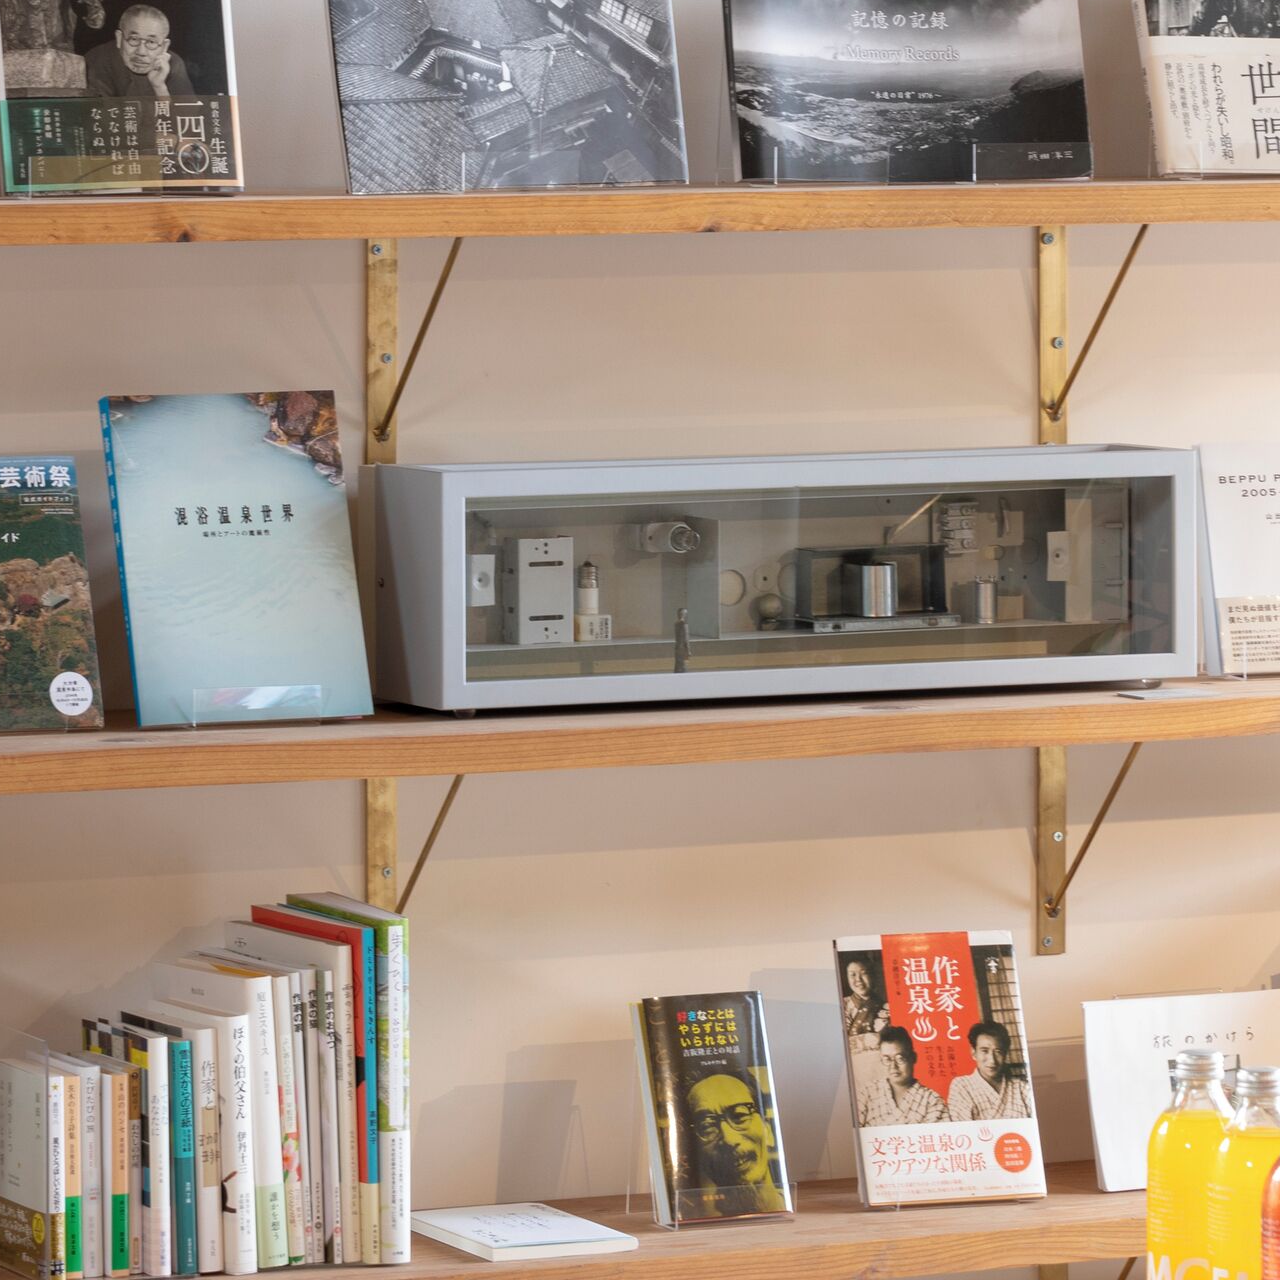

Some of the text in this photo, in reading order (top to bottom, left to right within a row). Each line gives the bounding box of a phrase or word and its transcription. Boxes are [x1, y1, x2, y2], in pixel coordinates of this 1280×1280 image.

[849, 10, 950, 31] 記憶の記録
[844, 45, 961, 62] Memory Records
[154, 100, 177, 175] 周年記念
[210, 136, 229, 175] 生誕
[1218, 474, 1267, 484] BEPPU
[174, 503, 295, 526] 混浴温泉世界
[902, 957, 935, 1016] 温泉
[931, 955, 964, 1041] 作家と
[676, 1008, 736, 1023] 好きなことは
[677, 1021, 737, 1035] やらずには
[1153, 1026, 1255, 1049] 旅のかけら
[680, 1034, 740, 1048] いられない
[233, 1027, 246, 1120] ぼくの伯父さん
[869, 1133, 973, 1157] 文学と温泉の
[872, 1152, 988, 1177] アツアツな関係
